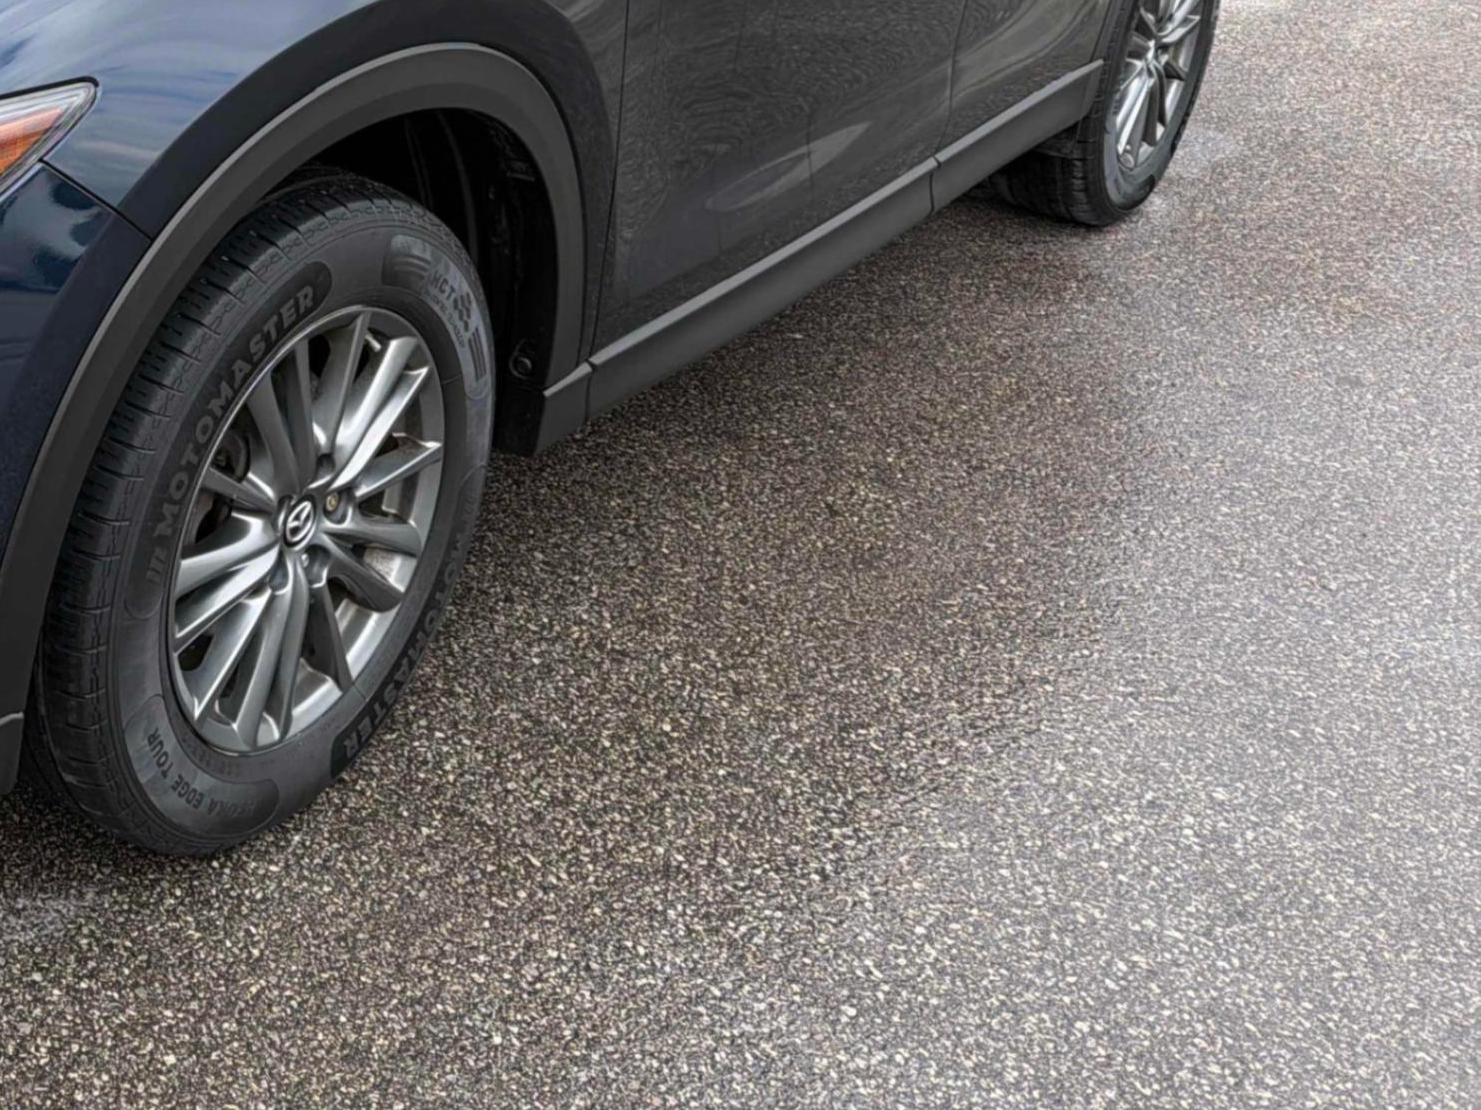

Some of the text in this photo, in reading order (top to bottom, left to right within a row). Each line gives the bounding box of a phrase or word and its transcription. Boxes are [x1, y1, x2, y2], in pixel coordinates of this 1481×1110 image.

[431, 270, 456, 300] HCT
[155, 286, 314, 538] MOTOMASTER
[342, 531, 467, 760] MOTOMASTER
[146, 727, 174, 779] TOUR
[171, 774, 206, 809] EDGE
